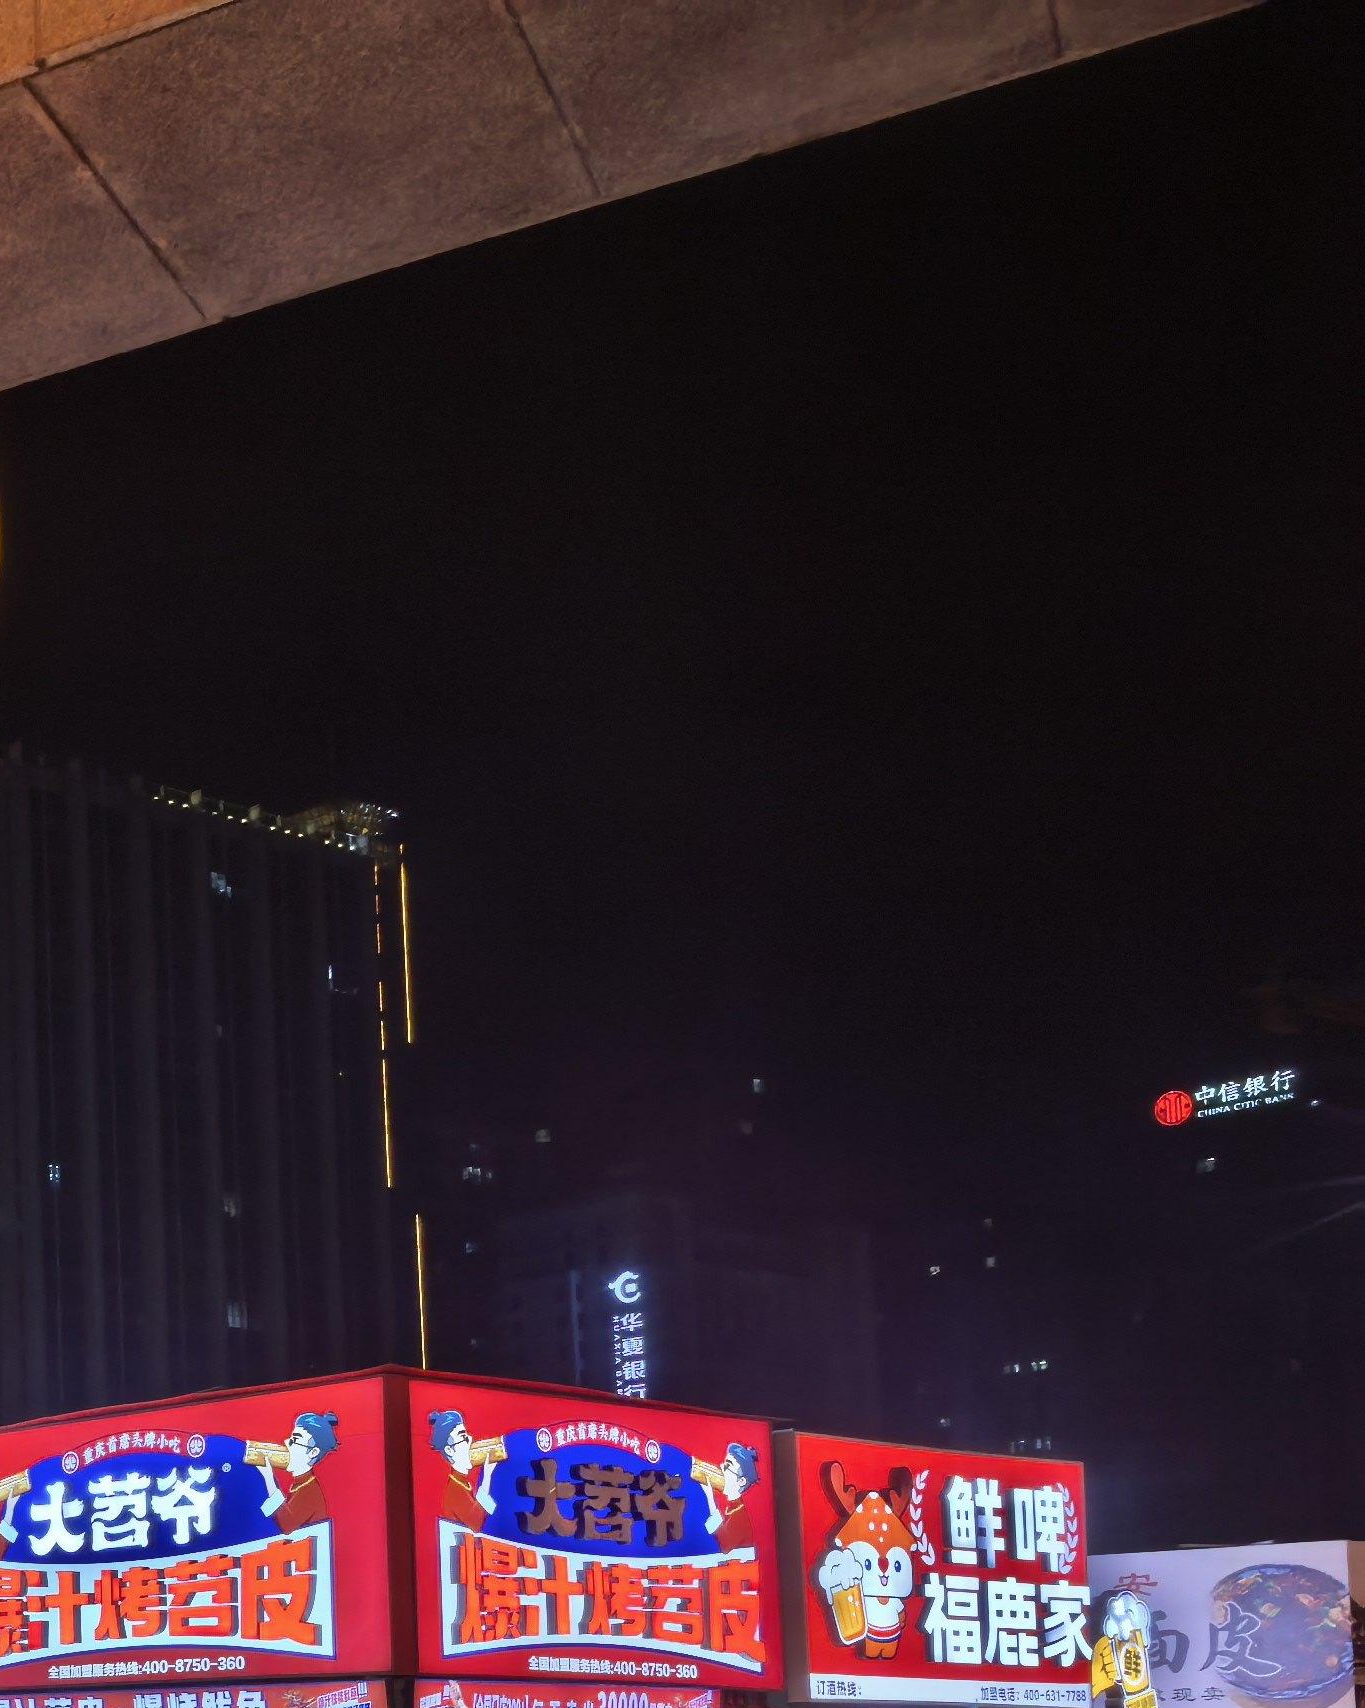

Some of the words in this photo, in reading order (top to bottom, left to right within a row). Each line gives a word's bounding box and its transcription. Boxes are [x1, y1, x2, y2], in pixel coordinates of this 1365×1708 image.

[1194, 1069, 1295, 1105] 中信银行
[1197, 1105, 1231, 1118] CHINA
[619, 1312, 647, 1399] 华夏银行
[82, 1431, 181, 1466] 重庆首席头牌小吃
[554, 1422, 641, 1455] 重庆首席头牌小吃
[28, 1465, 216, 1556] 大苕爷
[515, 1458, 687, 1548] 大苕爷
[944, 1474, 1069, 1573] 鲜啤
[450, 1530, 767, 1662] 爆汁烤苕皮
[924, 1574, 1094, 1668] 福鹿家
